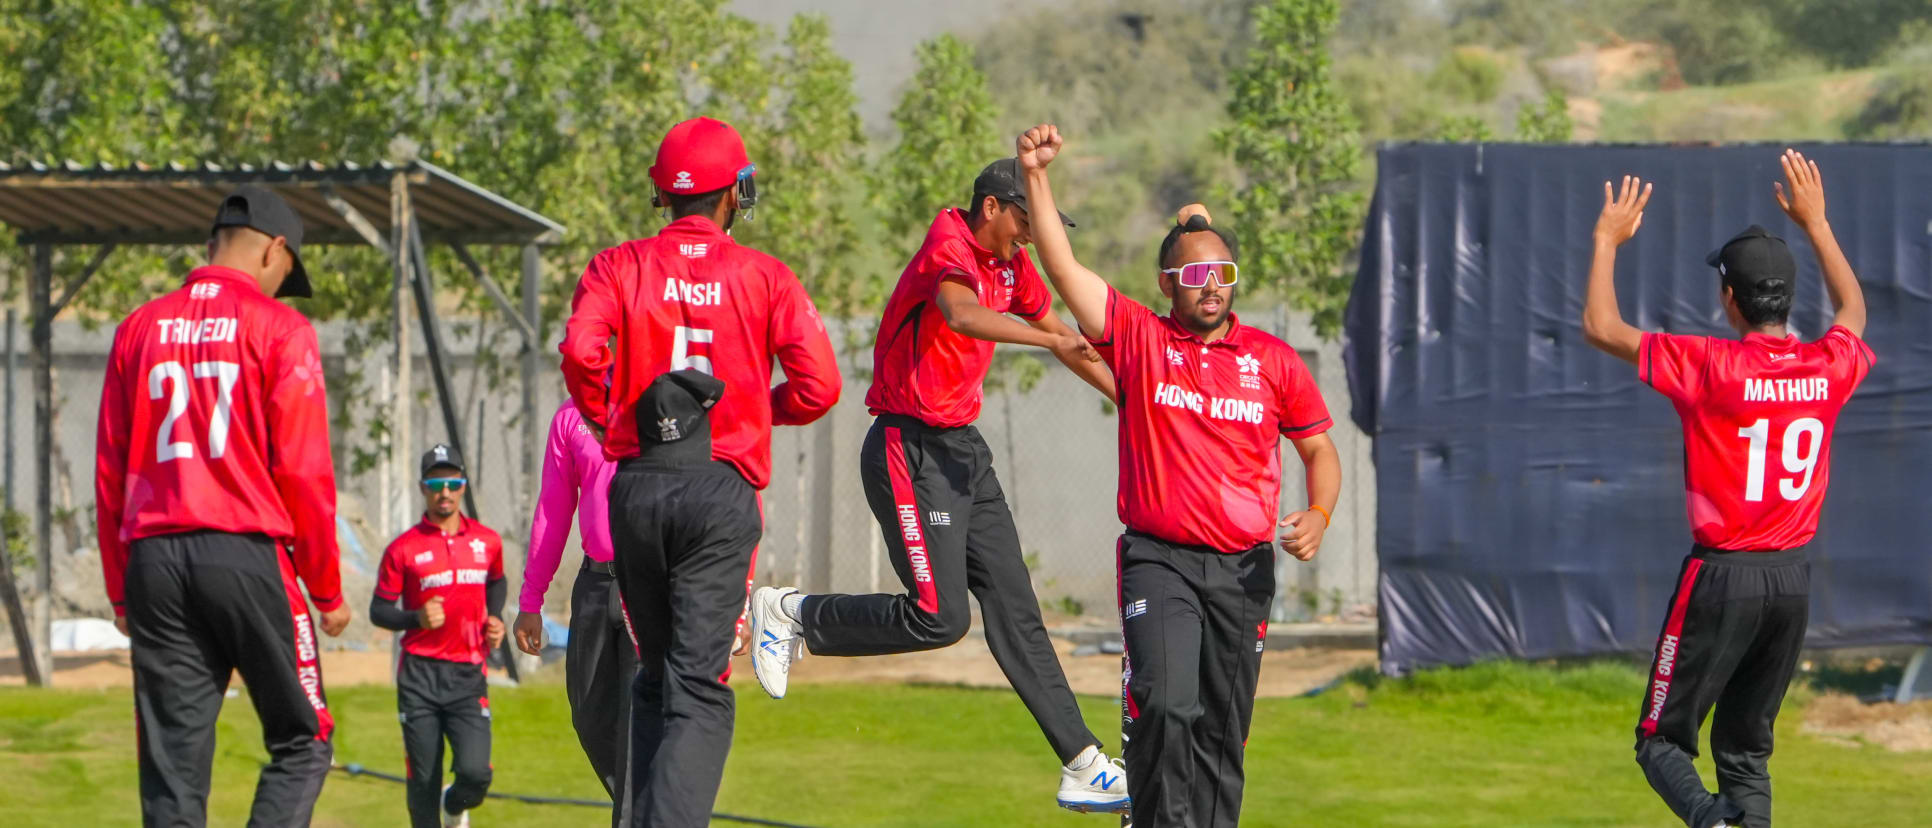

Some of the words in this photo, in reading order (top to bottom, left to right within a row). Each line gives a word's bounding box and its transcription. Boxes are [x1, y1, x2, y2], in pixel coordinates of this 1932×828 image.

[663, 277, 721, 306] ANSH
[157, 317, 238, 345] TRIVEDI
[670, 325, 714, 377] 5
[1154, 381, 1204, 414] HONG
[1210, 397, 1264, 425] KONG
[1744, 377, 1829, 401] MATHUR
[148, 360, 240, 463] 27
[1737, 417, 1825, 502] 19
[898, 504, 921, 541] HONG
[908, 546, 931, 582] KONG
[1658, 634, 1679, 676] HONG
[1649, 679, 1670, 721] KONG
